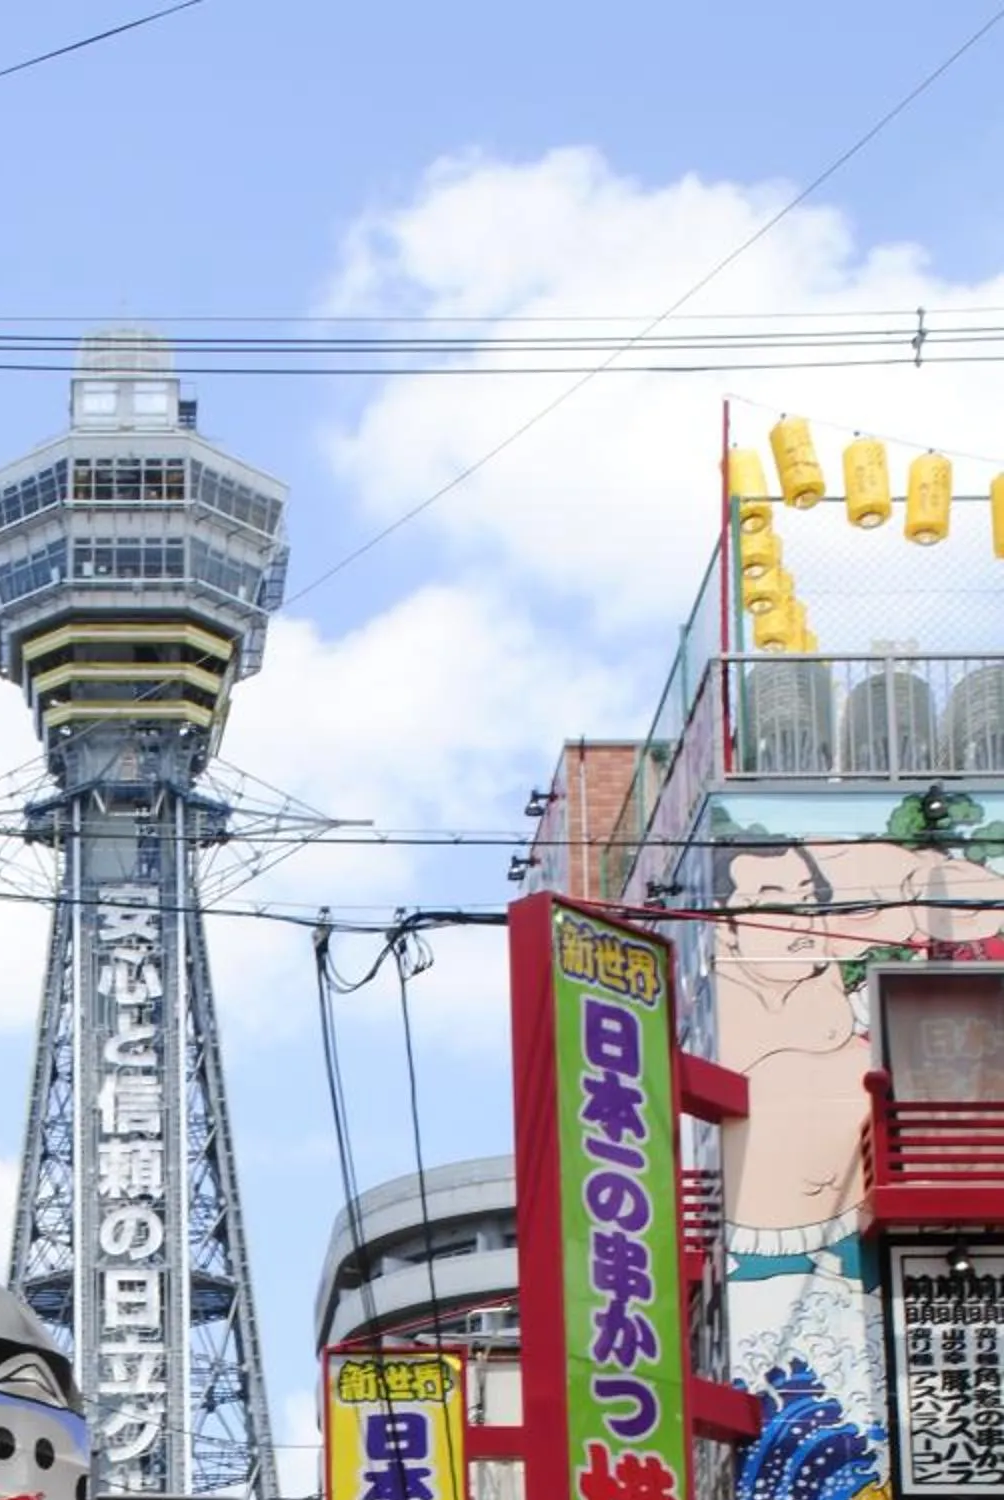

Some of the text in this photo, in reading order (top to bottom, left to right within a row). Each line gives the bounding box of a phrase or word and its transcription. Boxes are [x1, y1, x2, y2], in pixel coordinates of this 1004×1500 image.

[559, 917, 661, 1005] 新世界
[340, 1360, 453, 1403] 新世界
